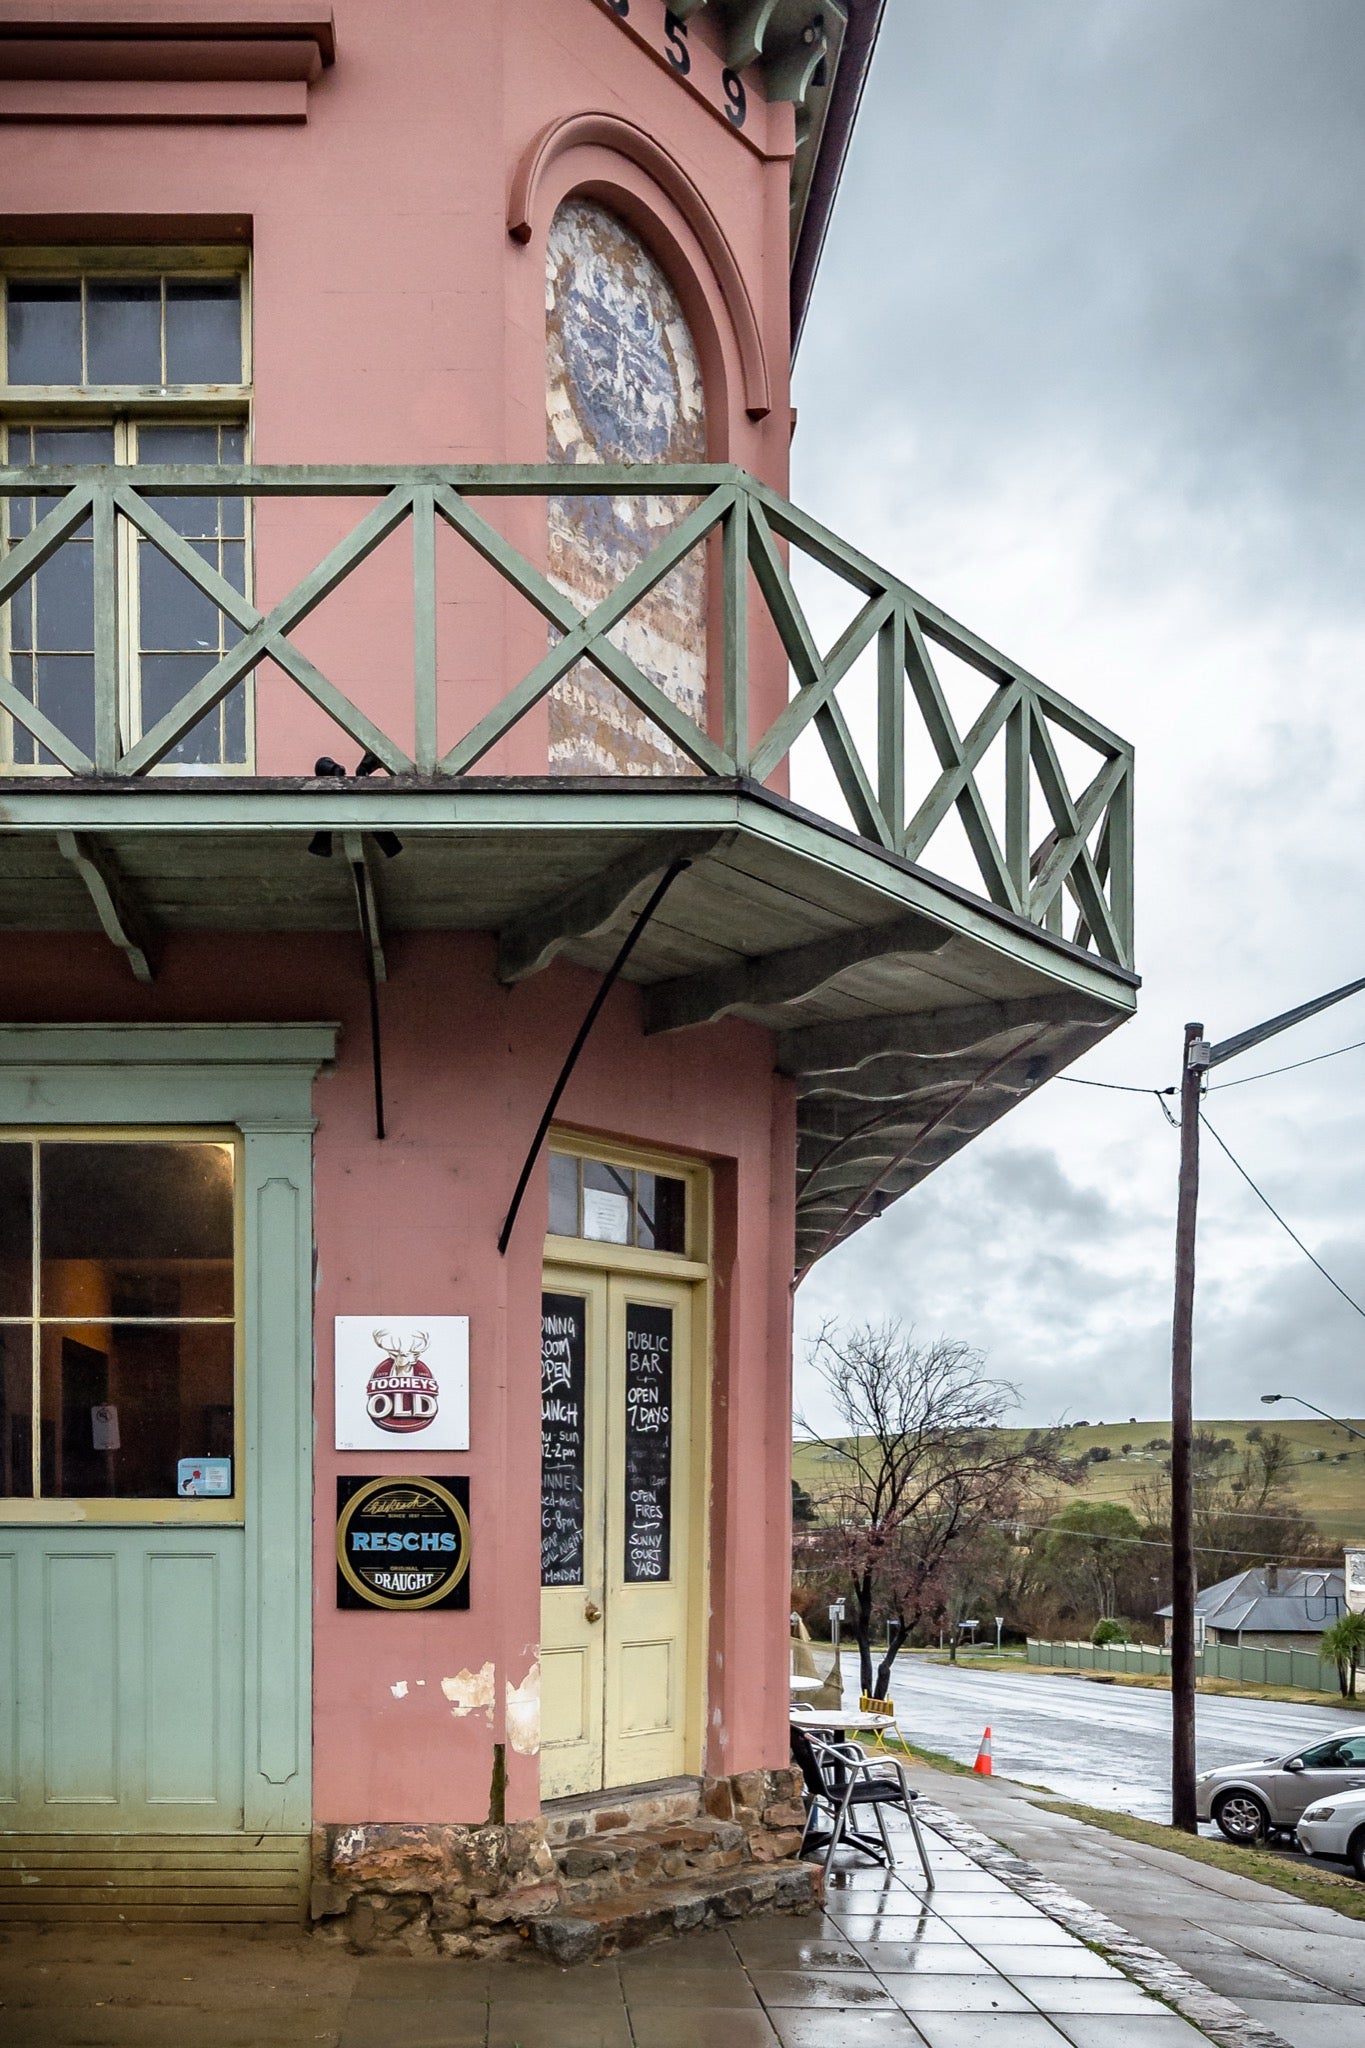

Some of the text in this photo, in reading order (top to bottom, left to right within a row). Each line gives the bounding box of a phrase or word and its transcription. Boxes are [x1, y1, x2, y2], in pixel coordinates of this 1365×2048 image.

[627, 1331, 669, 1352] PUBLIC
[630, 1353, 663, 1374] BAR
[370, 1377, 438, 1391] TOOHEYS
[627, 1386, 659, 1404] OPEN
[367, 1393, 438, 1419] OLD
[541, 1398, 578, 1427] UNCH
[627, 1404, 669, 1427] 7 DAYS
[543, 1473, 582, 1491] INNER
[630, 1489, 657, 1504] OPEN
[635, 1504, 663, 1519] FIRES
[351, 1531, 457, 1552] RESCHS
[628, 1533, 662, 1549] SUNNY
[630, 1548, 662, 1561] COURT
[544, 1566, 581, 1584] MONDAY
[632, 1560, 662, 1577] YARD
[374, 1573, 434, 1591] DRAUGHT
